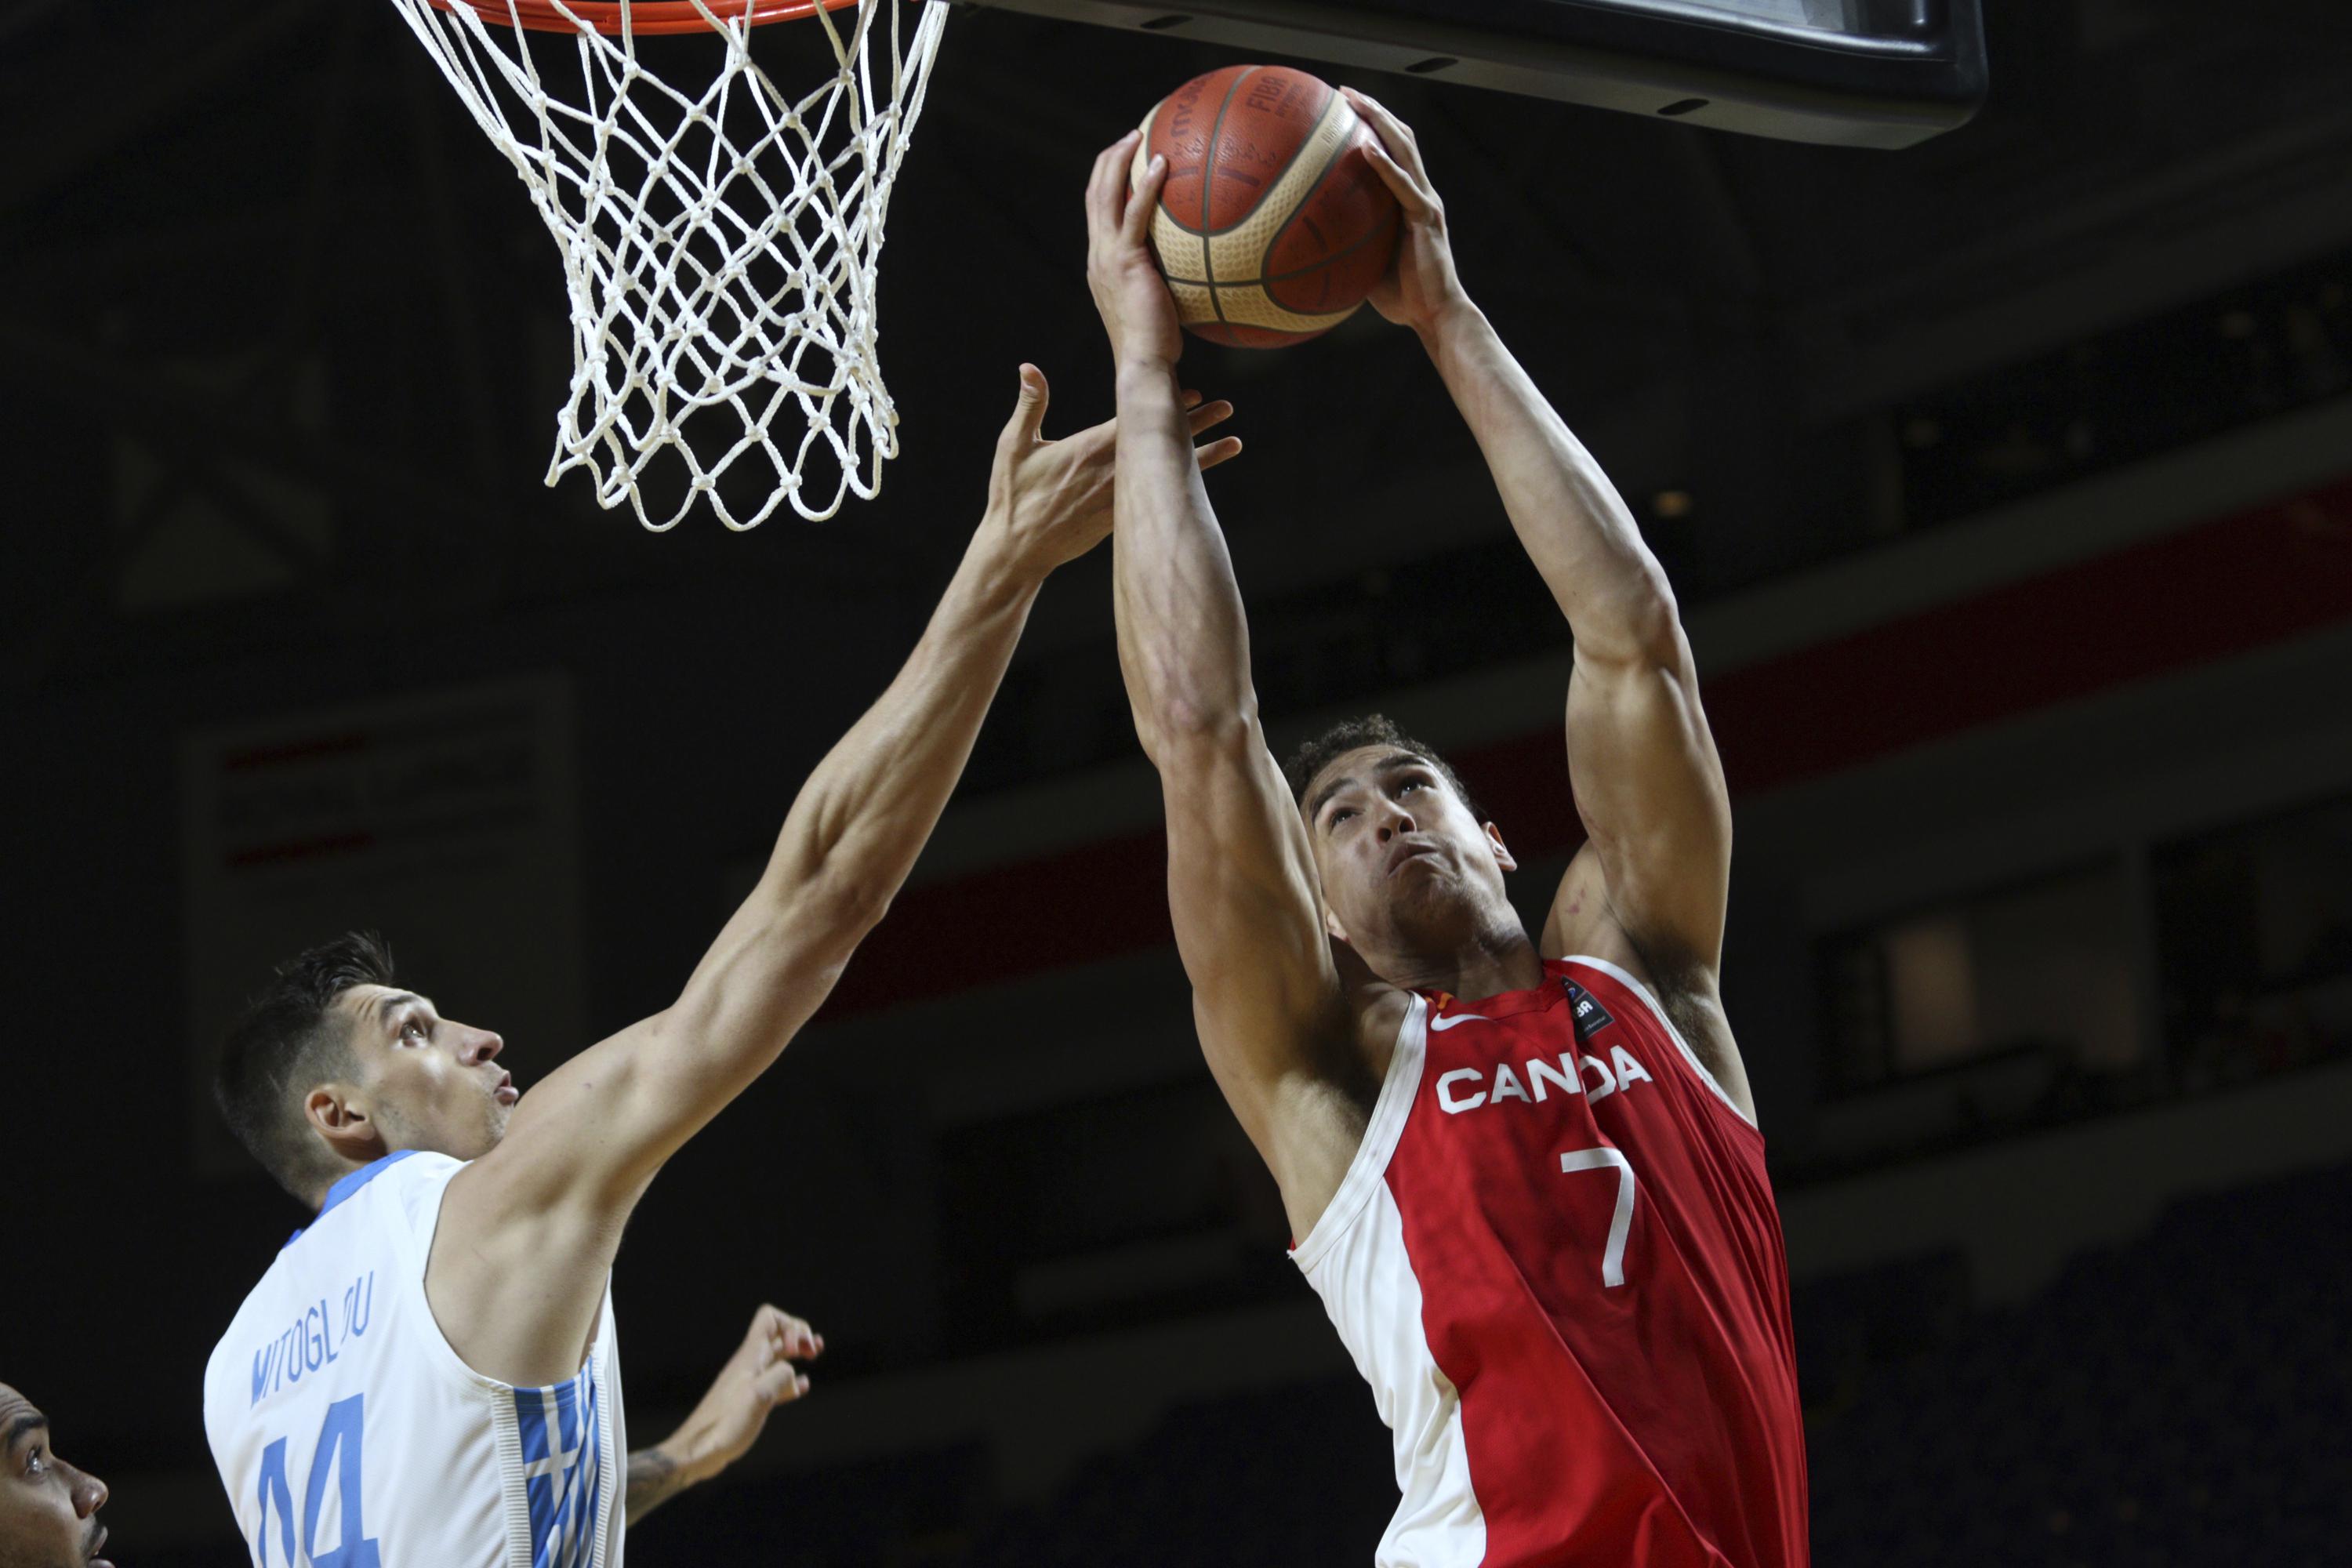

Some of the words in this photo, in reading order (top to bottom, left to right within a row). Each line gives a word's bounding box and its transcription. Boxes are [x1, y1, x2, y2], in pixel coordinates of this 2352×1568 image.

[1246, 76, 1288, 111] FIBA
[1436, 1044, 1653, 1115] CANDA
[1560, 1146, 1635, 1288] 7
